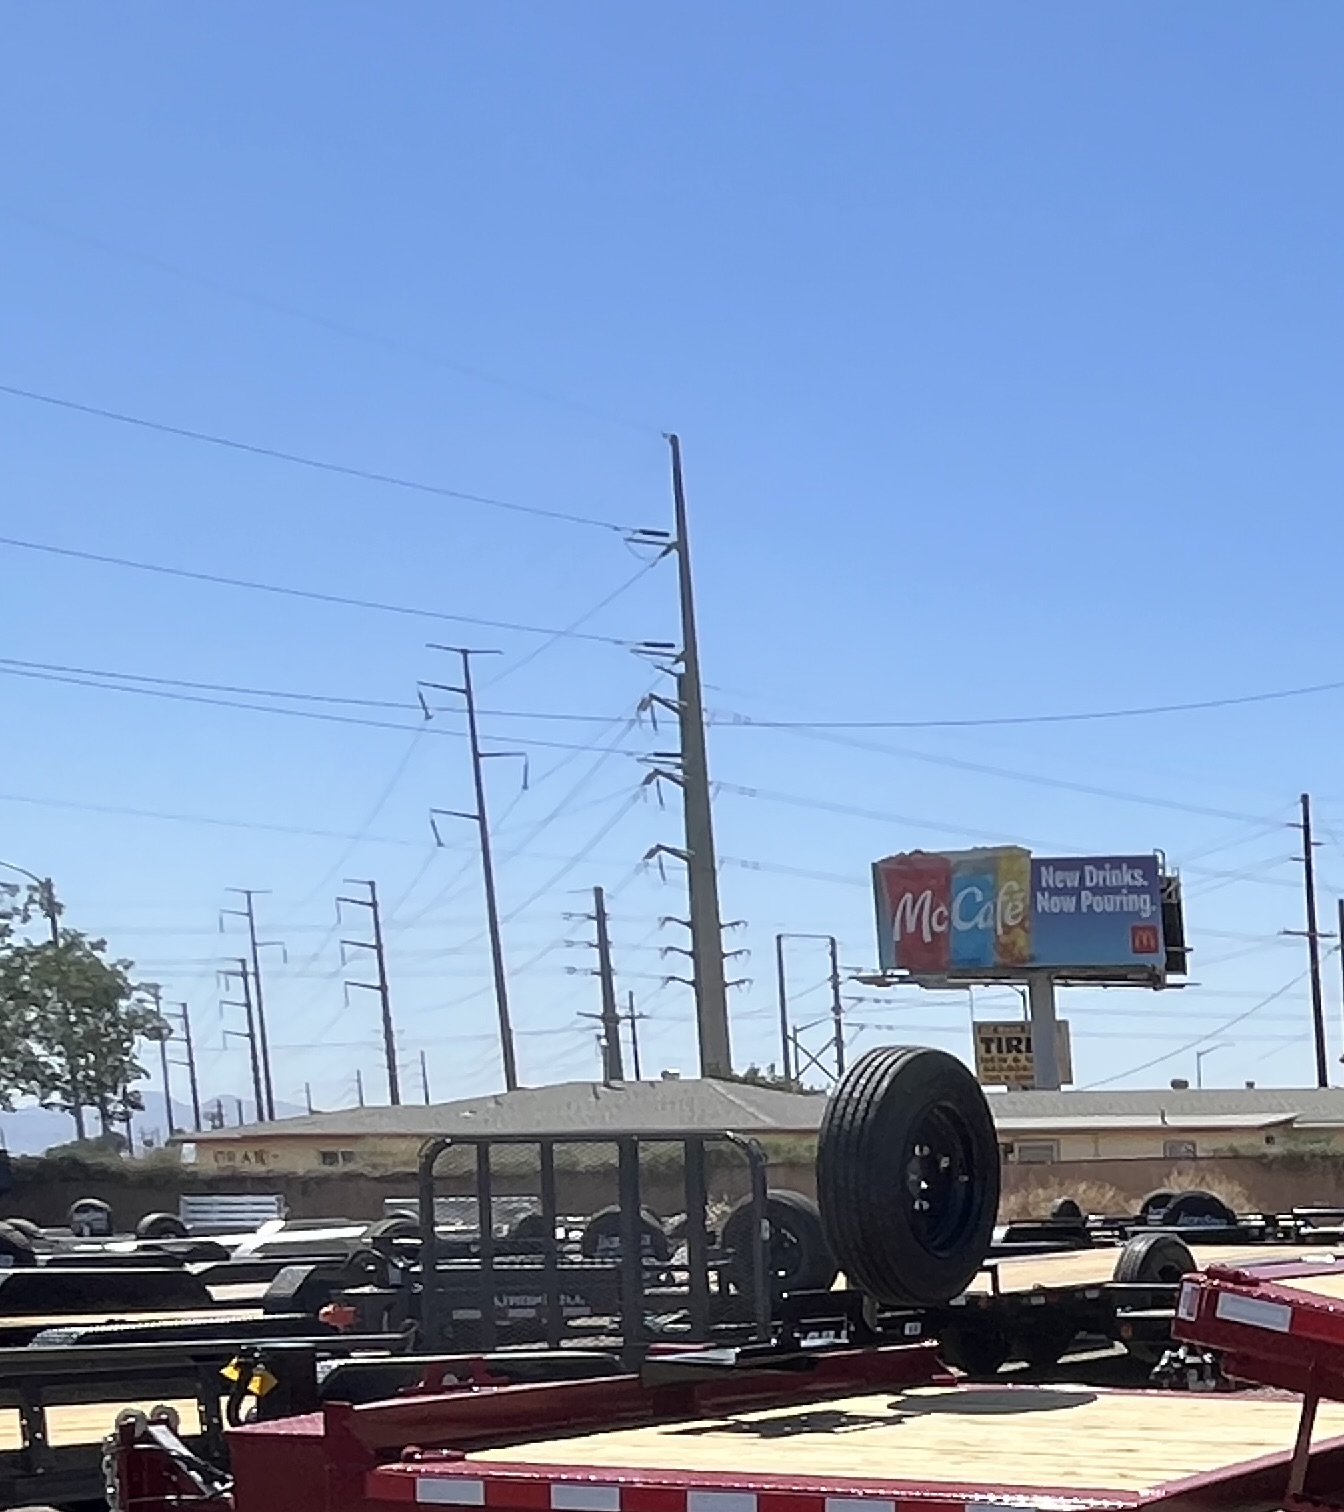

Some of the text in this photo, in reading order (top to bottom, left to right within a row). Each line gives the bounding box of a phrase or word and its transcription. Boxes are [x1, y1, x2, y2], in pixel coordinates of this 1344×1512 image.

[1041, 862, 1148, 888] New Drinks.
[894, 880, 1025, 942] McCafé
[1036, 889, 1157, 918] Now Pouring.
